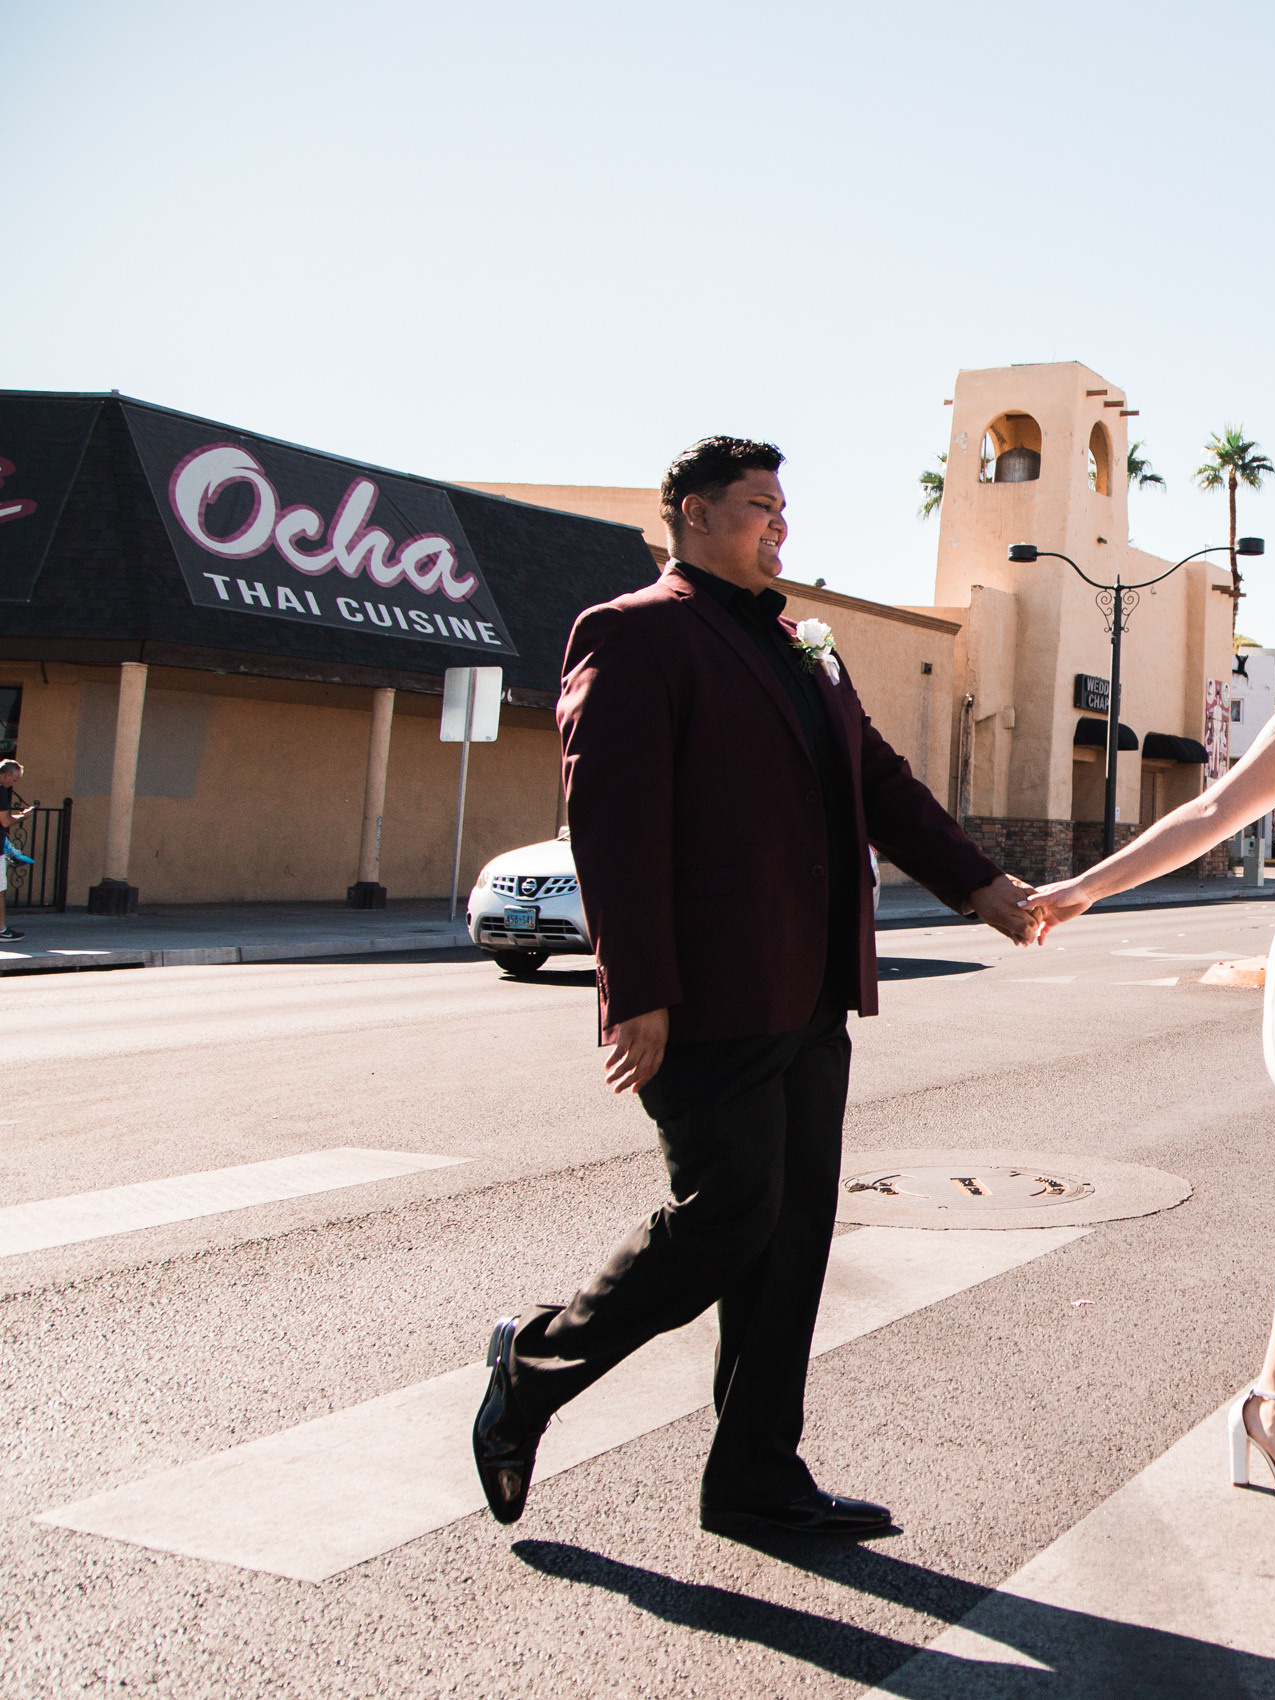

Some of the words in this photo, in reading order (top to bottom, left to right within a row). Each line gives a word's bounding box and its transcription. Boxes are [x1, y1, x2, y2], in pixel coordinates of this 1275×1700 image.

[169, 442, 479, 602] Ocha
[203, 572, 321, 615] THAI
[336, 597, 501, 645] CUISINE
[1086, 677, 1110, 696] WEDD
[1088, 694, 1110, 710] CHAP
